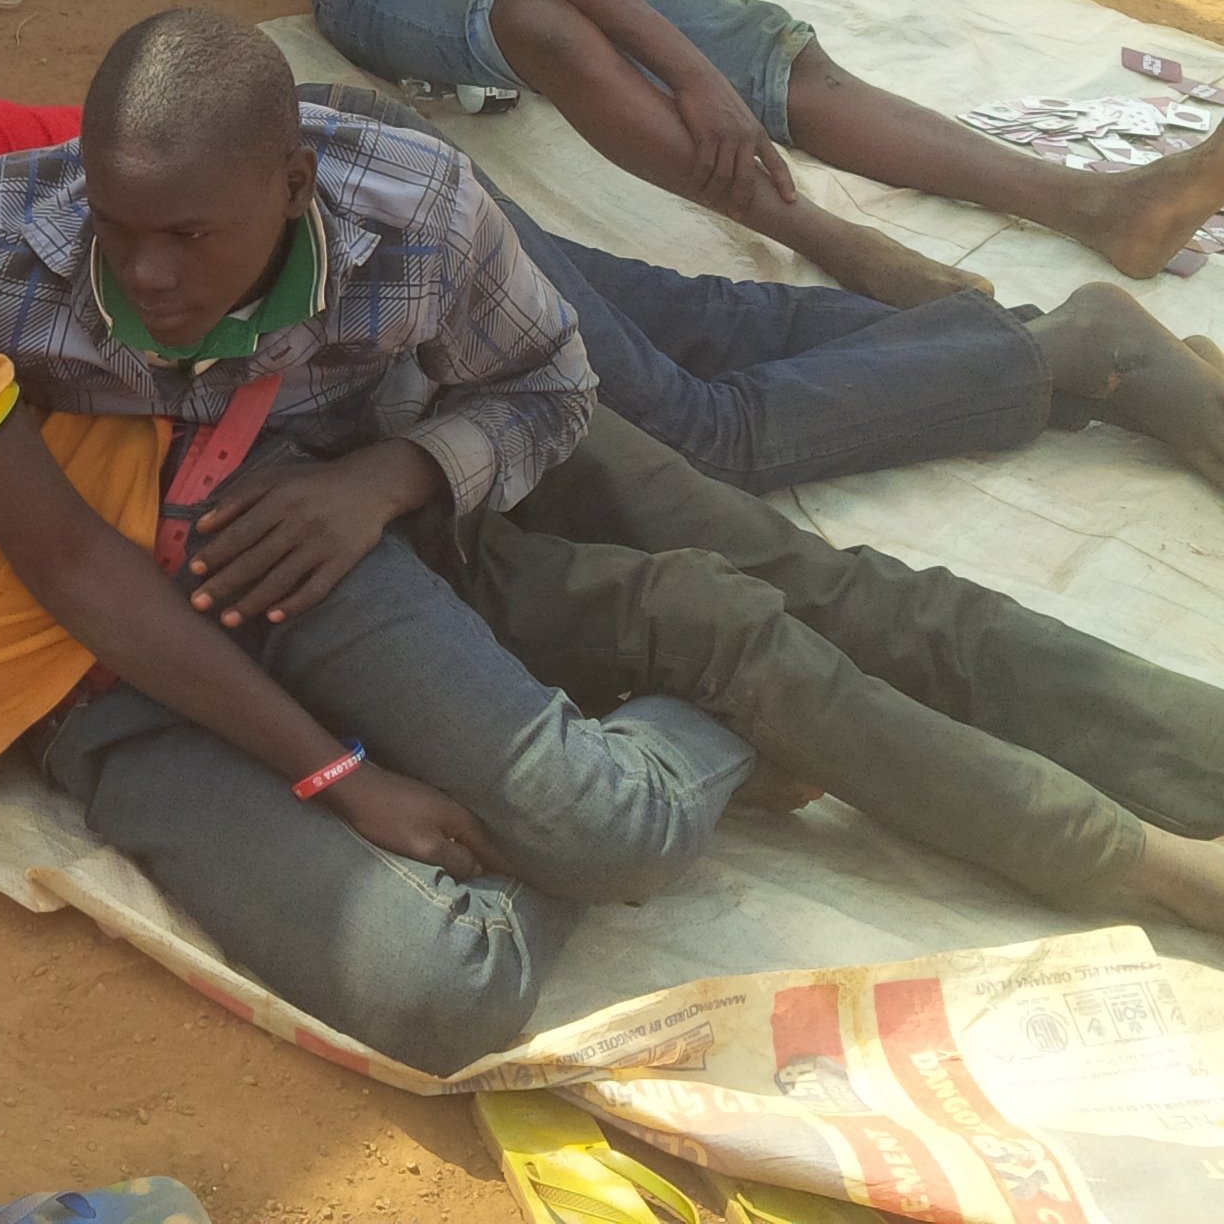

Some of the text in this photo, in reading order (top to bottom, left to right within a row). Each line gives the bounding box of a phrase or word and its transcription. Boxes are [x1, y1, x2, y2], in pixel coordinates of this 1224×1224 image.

[556, 993, 748, 1065] MANUFACTURED BY DANGOTE CEMEN
